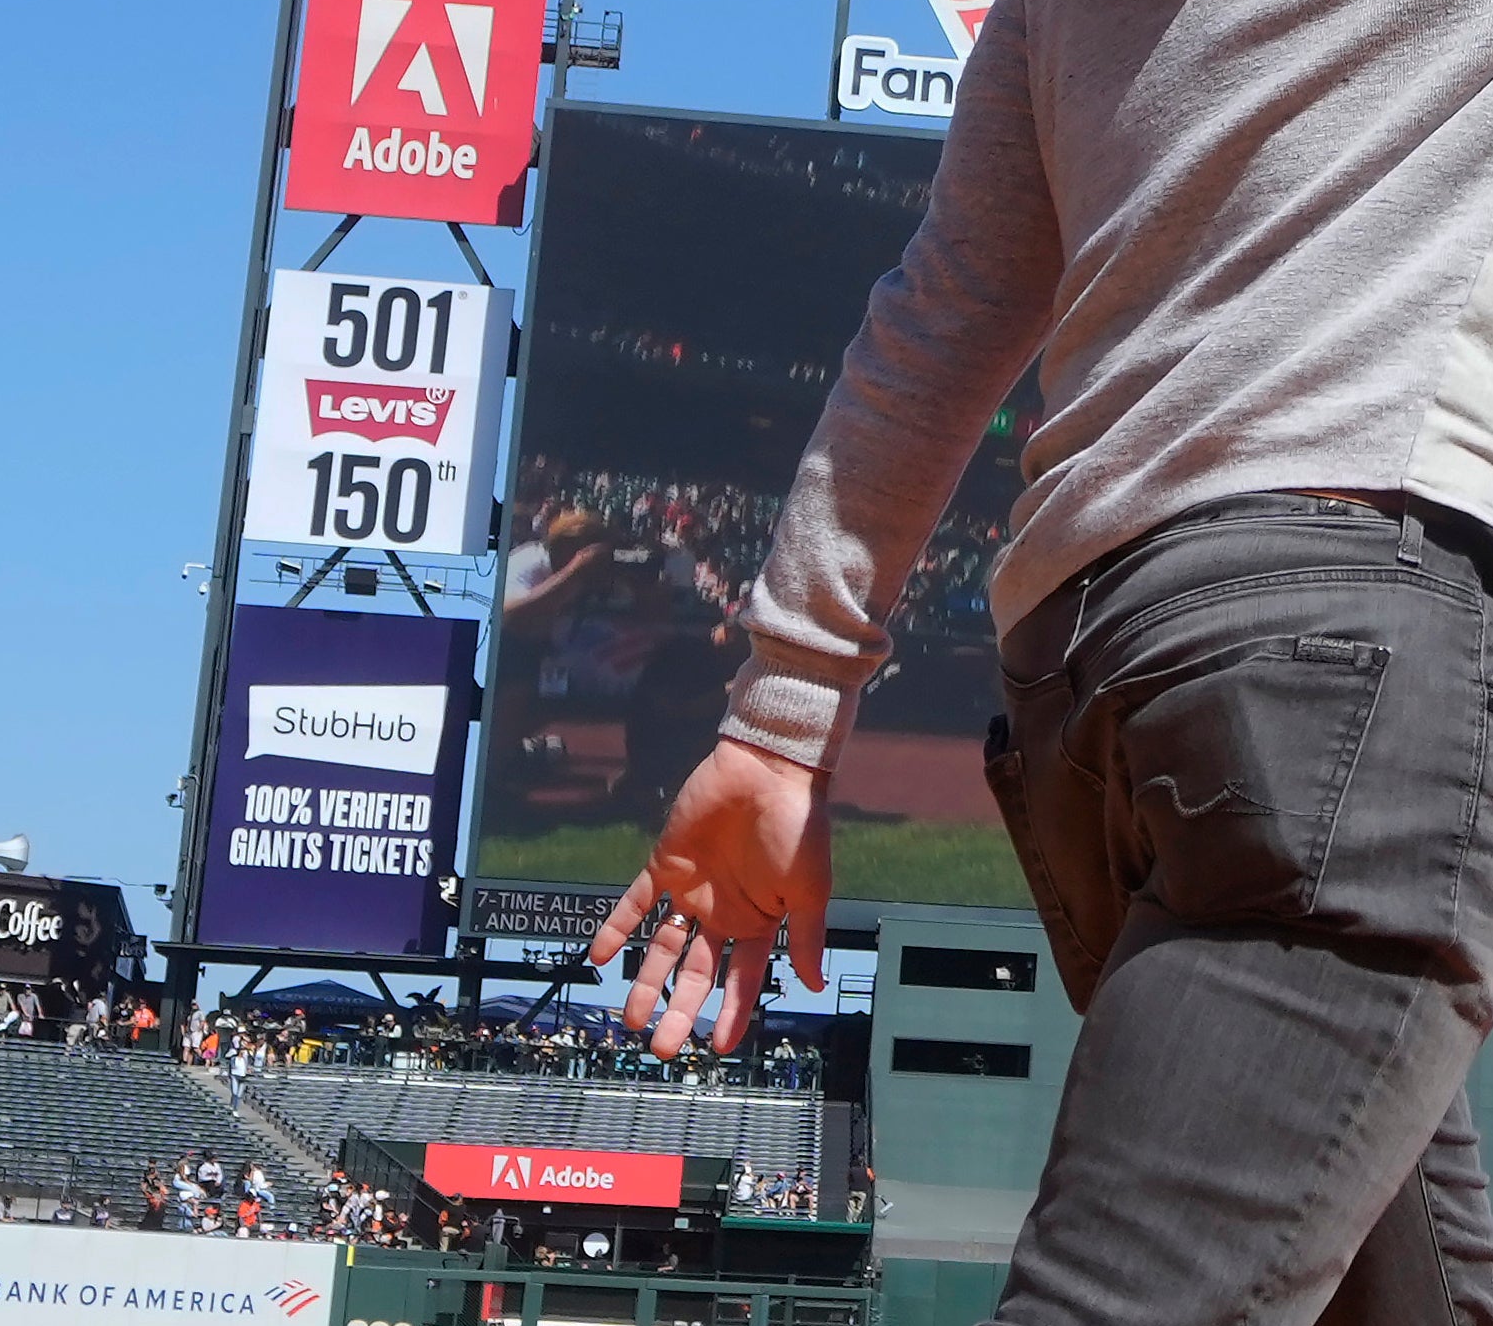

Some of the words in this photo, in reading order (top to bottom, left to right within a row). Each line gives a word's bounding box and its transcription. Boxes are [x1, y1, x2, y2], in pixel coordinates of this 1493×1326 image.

[851, 48, 954, 104] Fan
[342, 127, 477, 179] Adobe
[323, 282, 453, 374] 501
[273, 706, 416, 742] StubHub
[244, 784, 313, 825] 100%
[319, 789, 432, 832] VERIFIED
[229, 828, 324, 870] GIANTS
[329, 834, 434, 877] TICKETS
[477, 891, 545, 911] 7-TIME
[549, 894, 615, 915] ALL-ST
[485, 913, 528, 933] AND
[539, 1165, 615, 1189] Adobe
[79, 1285, 115, 1307] OF
[123, 1288, 255, 1315] AMERICA
